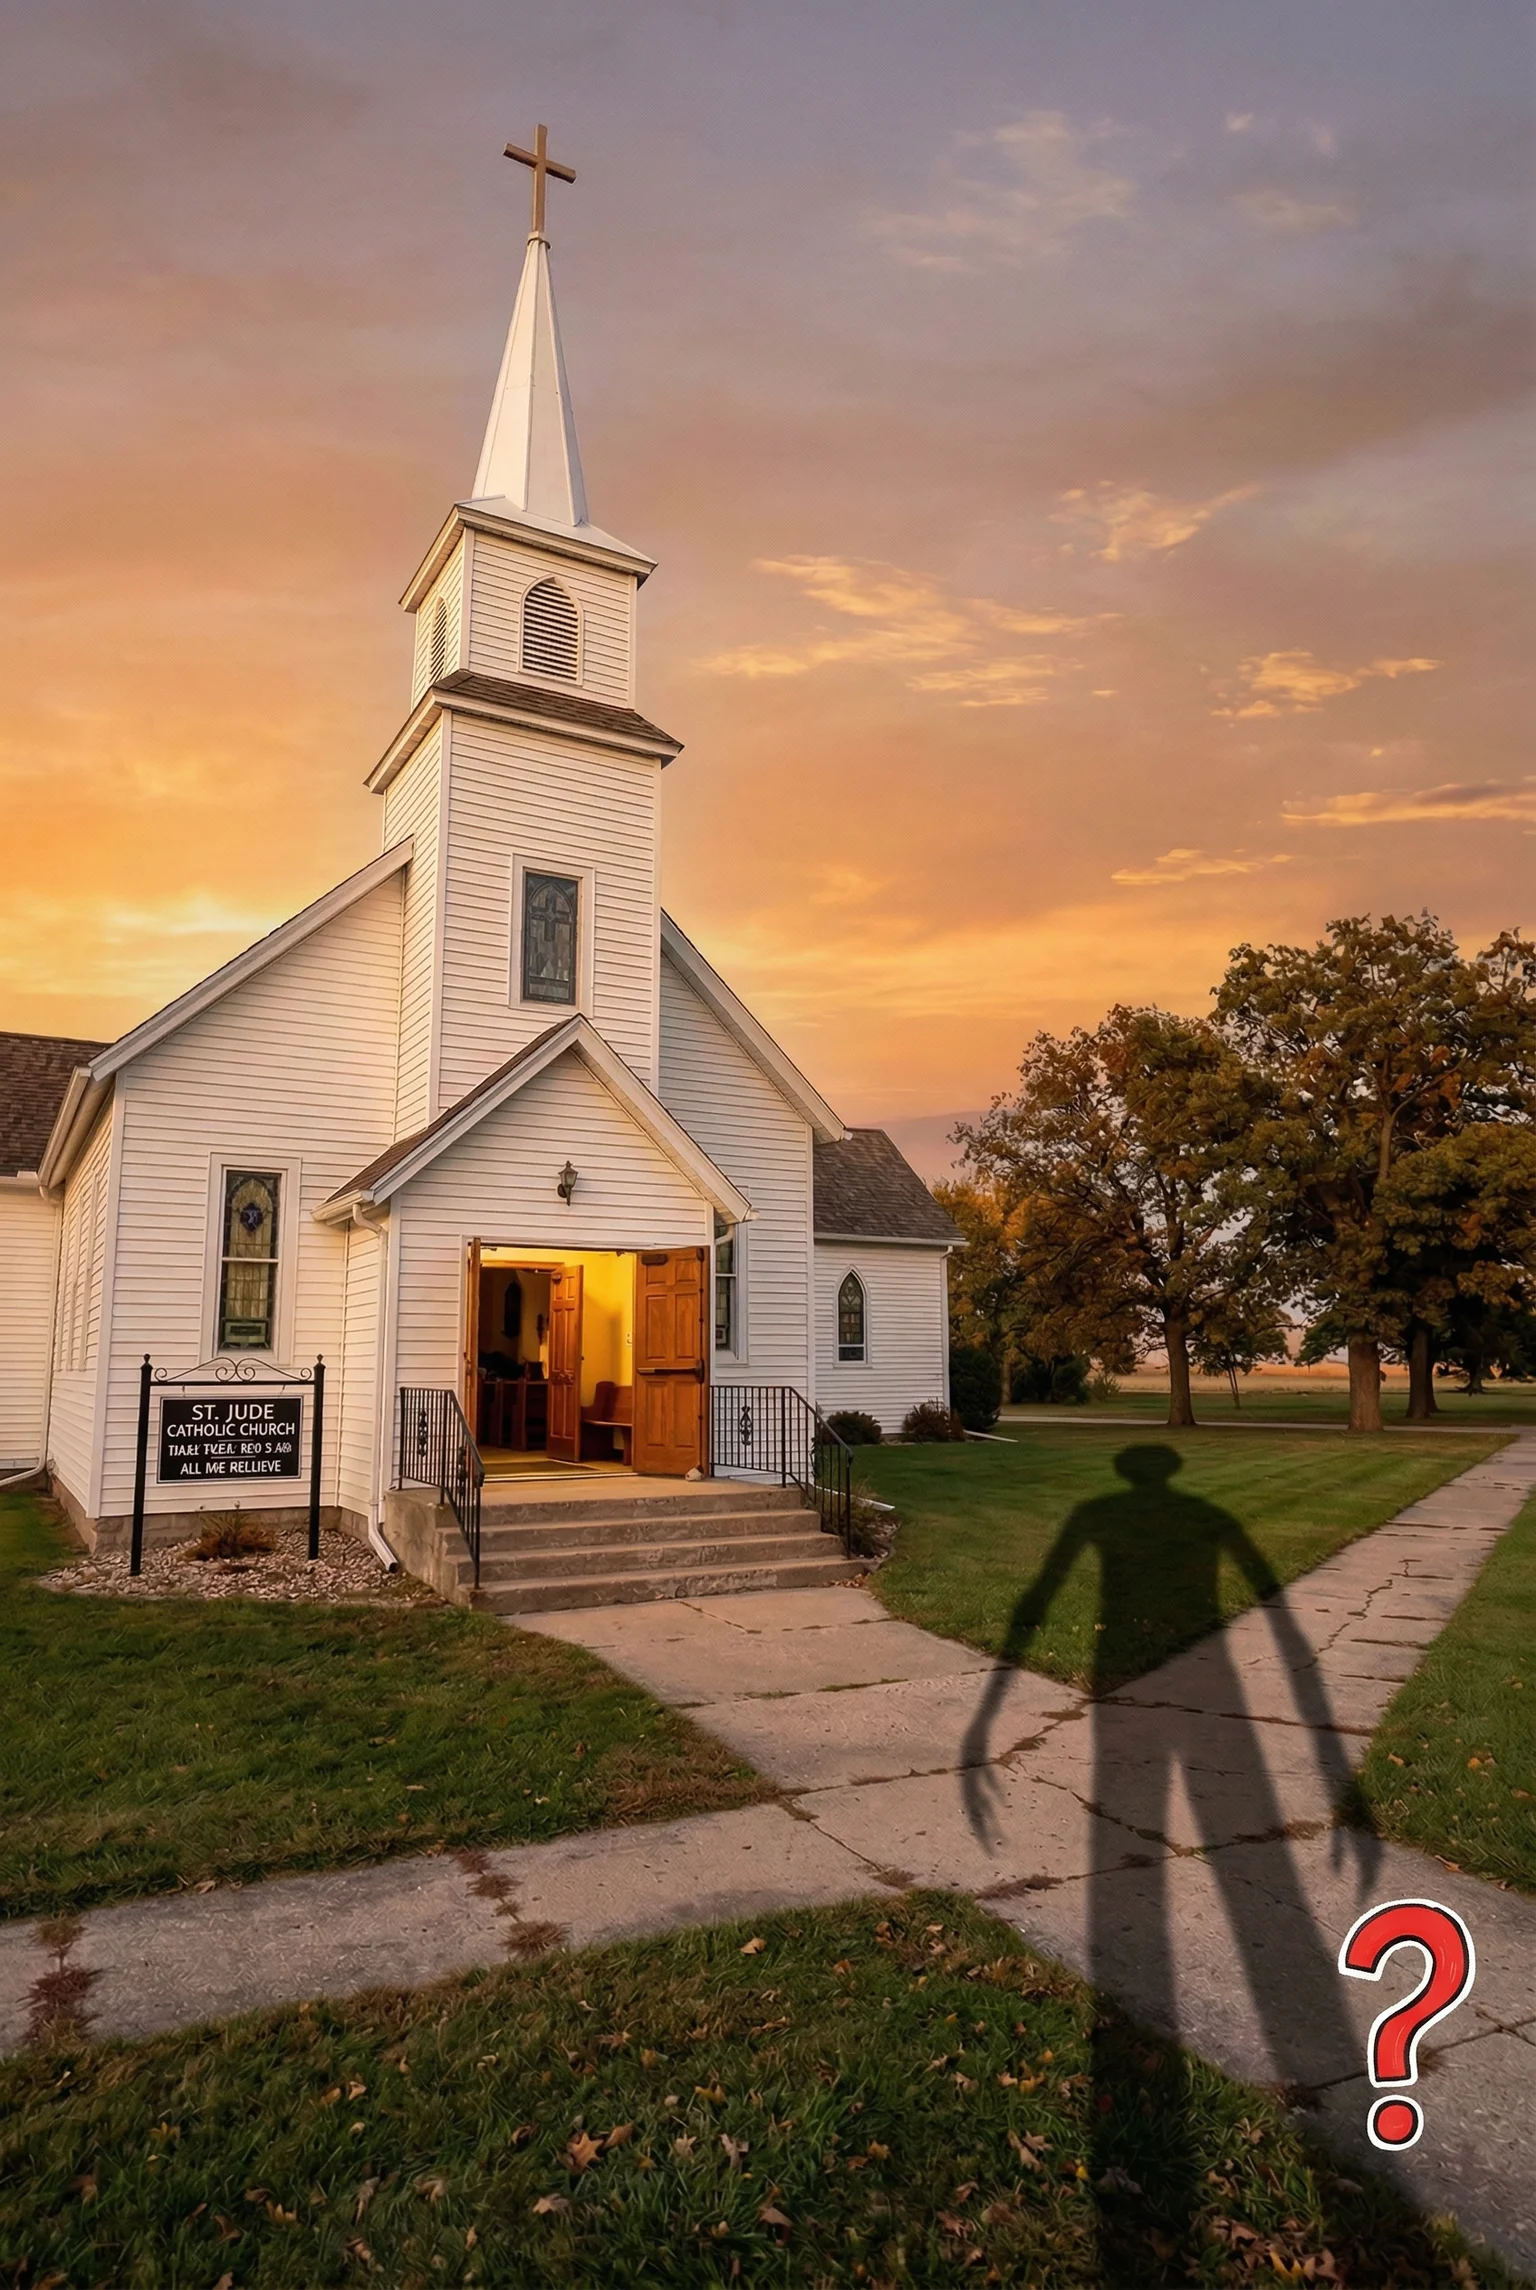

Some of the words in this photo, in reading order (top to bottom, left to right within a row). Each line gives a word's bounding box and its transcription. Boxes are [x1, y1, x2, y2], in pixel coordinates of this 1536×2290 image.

[192, 1404, 219, 1421] ST.
[226, 1404, 274, 1423] JUDE
[167, 1424, 235, 1437] CATHOLIC
[240, 1423, 295, 1436] CHURCH
[180, 1462, 201, 1475] ALL
[230, 1460, 281, 1473] RELLIEVE
